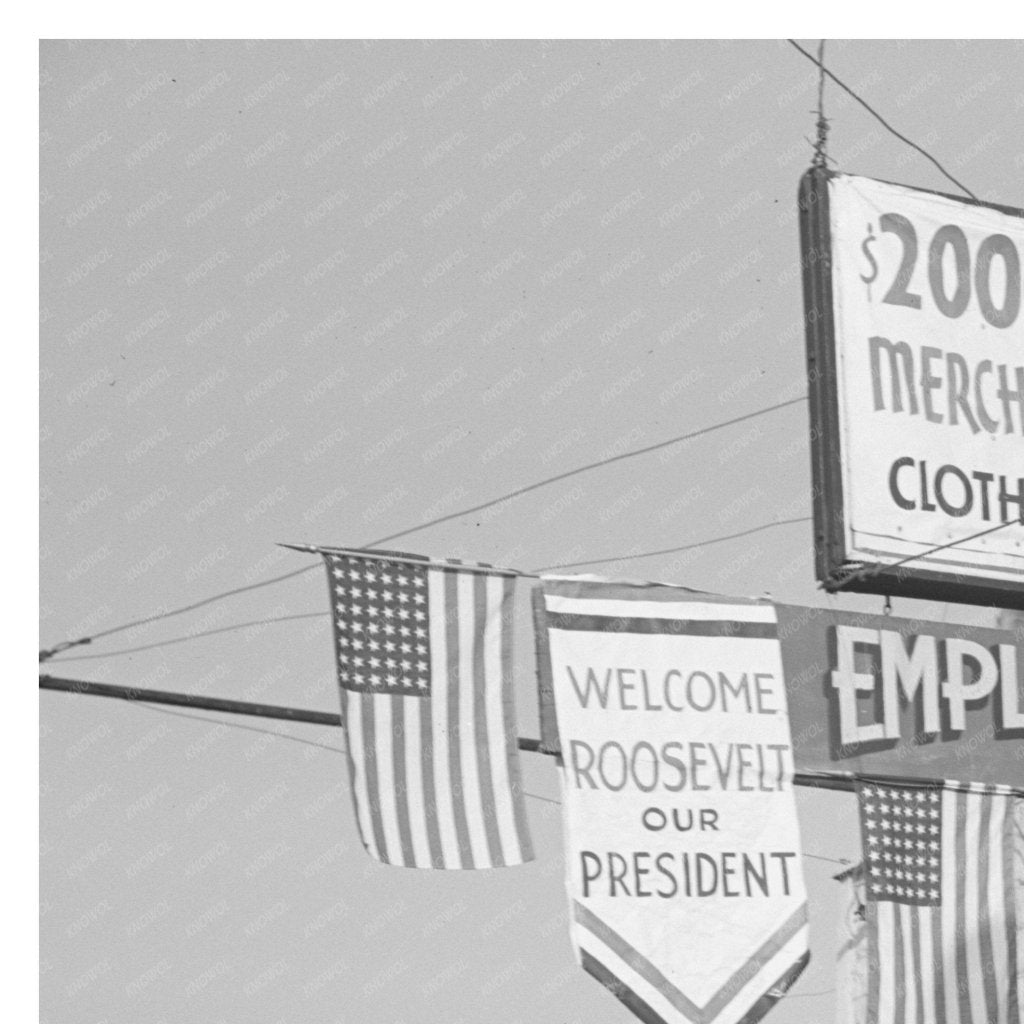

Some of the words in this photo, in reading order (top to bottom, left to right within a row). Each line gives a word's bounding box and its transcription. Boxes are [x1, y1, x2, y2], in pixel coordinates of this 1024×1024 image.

[566, 665, 778, 715] WELCOME
[569, 739, 790, 793] ROOSEVELT
[642, 806, 720, 832] OUR
[580, 850, 796, 899] PRESIDENT
